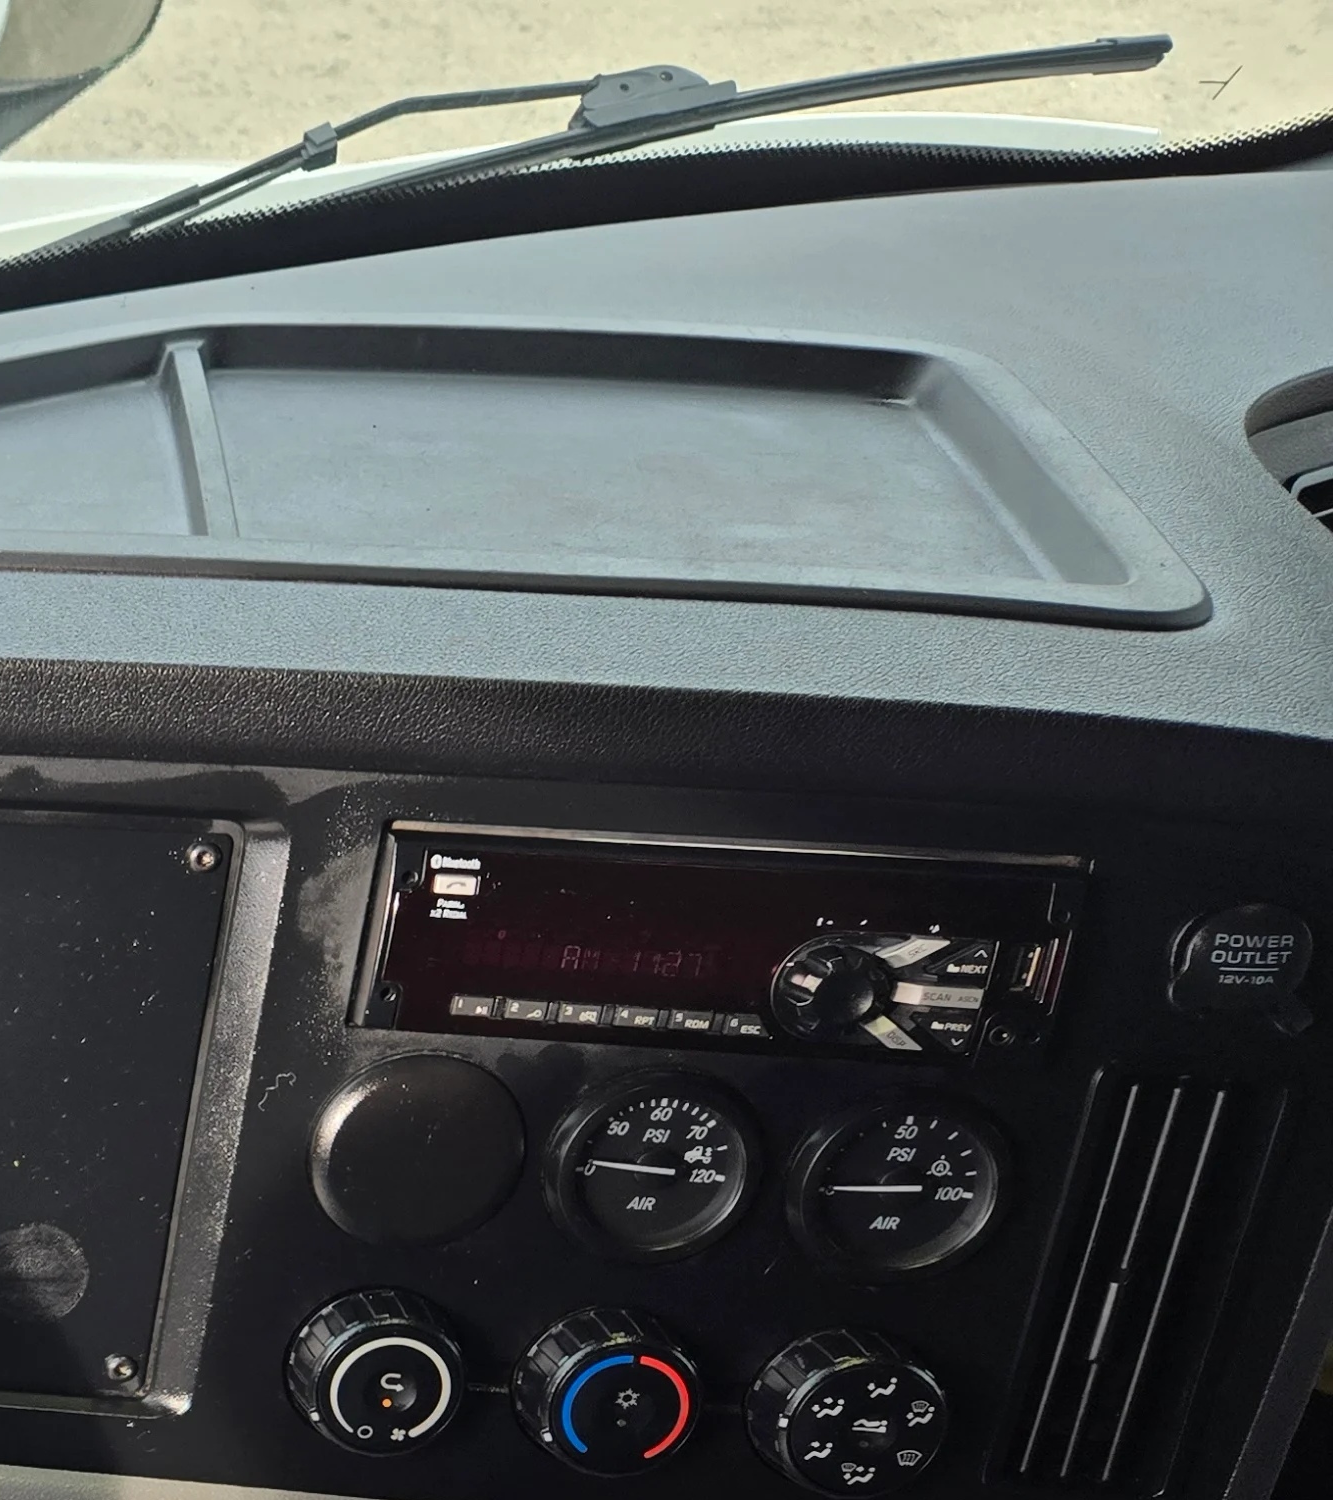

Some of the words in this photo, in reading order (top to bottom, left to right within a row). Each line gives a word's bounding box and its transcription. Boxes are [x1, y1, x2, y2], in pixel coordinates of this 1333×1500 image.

[1214, 933, 1294, 948] POWER
[1210, 950, 1292, 965] OUTLET
[960, 964, 988, 975] NEXT
[1218, 974, 1274, 985] 12V-10A
[923, 992, 952, 1002] SCAN
[510, 1002, 520, 1013] 2
[634, 1015, 656, 1027] RPT
[684, 1019, 709, 1030] RDM
[944, 1022, 973, 1033] PREV
[740, 1024, 761, 1036] ESC
[650, 1107, 673, 1121] 60
[607, 1121, 630, 1136] 50
[642, 1128, 671, 1143] PSI
[685, 1126, 709, 1140] 70
[894, 1125, 918, 1140] 50
[886, 1147, 917, 1162] PSI
[688, 1169, 716, 1184] 120
[934, 1187, 963, 1201] 100
[626, 1196, 657, 1211] AIR
[869, 1216, 901, 1230] AIR
